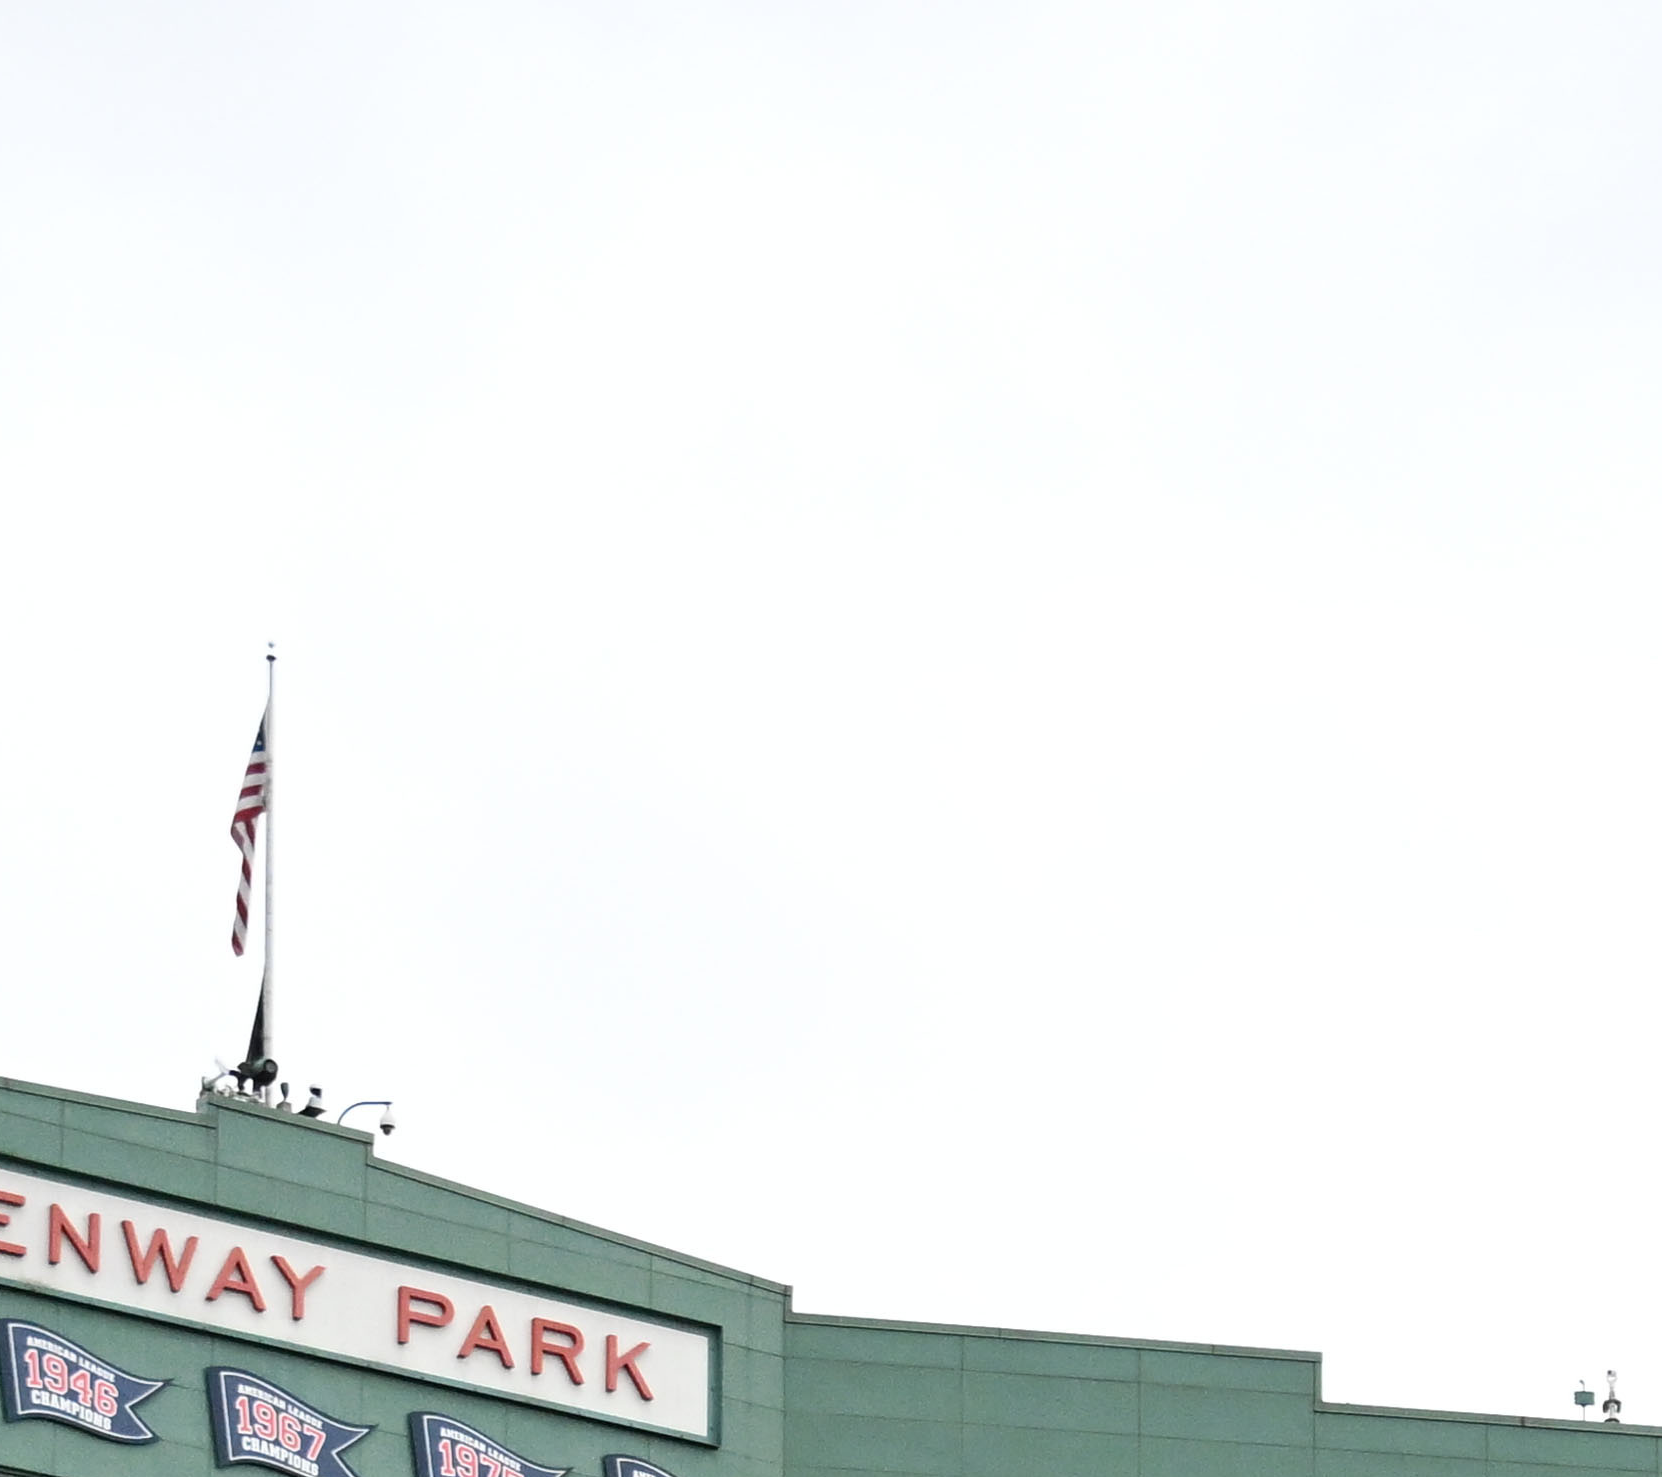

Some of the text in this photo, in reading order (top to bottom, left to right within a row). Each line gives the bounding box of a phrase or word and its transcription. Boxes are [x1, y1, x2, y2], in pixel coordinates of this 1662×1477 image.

[27, 1335, 116, 1383] AMERICAN LEAGUE
[396, 1284, 656, 1402] PARK
[24, 1347, 119, 1417] 1946
[31, 1389, 112, 1431] CHAMPIONS
[235, 1396, 326, 1462] 1967
[238, 1384, 323, 1429] AMERICAN LEAGUE
[241, 1436, 319, 1477] CHAMPIONS
[440, 1427, 521, 1471] AMERICAN LEAGUE
